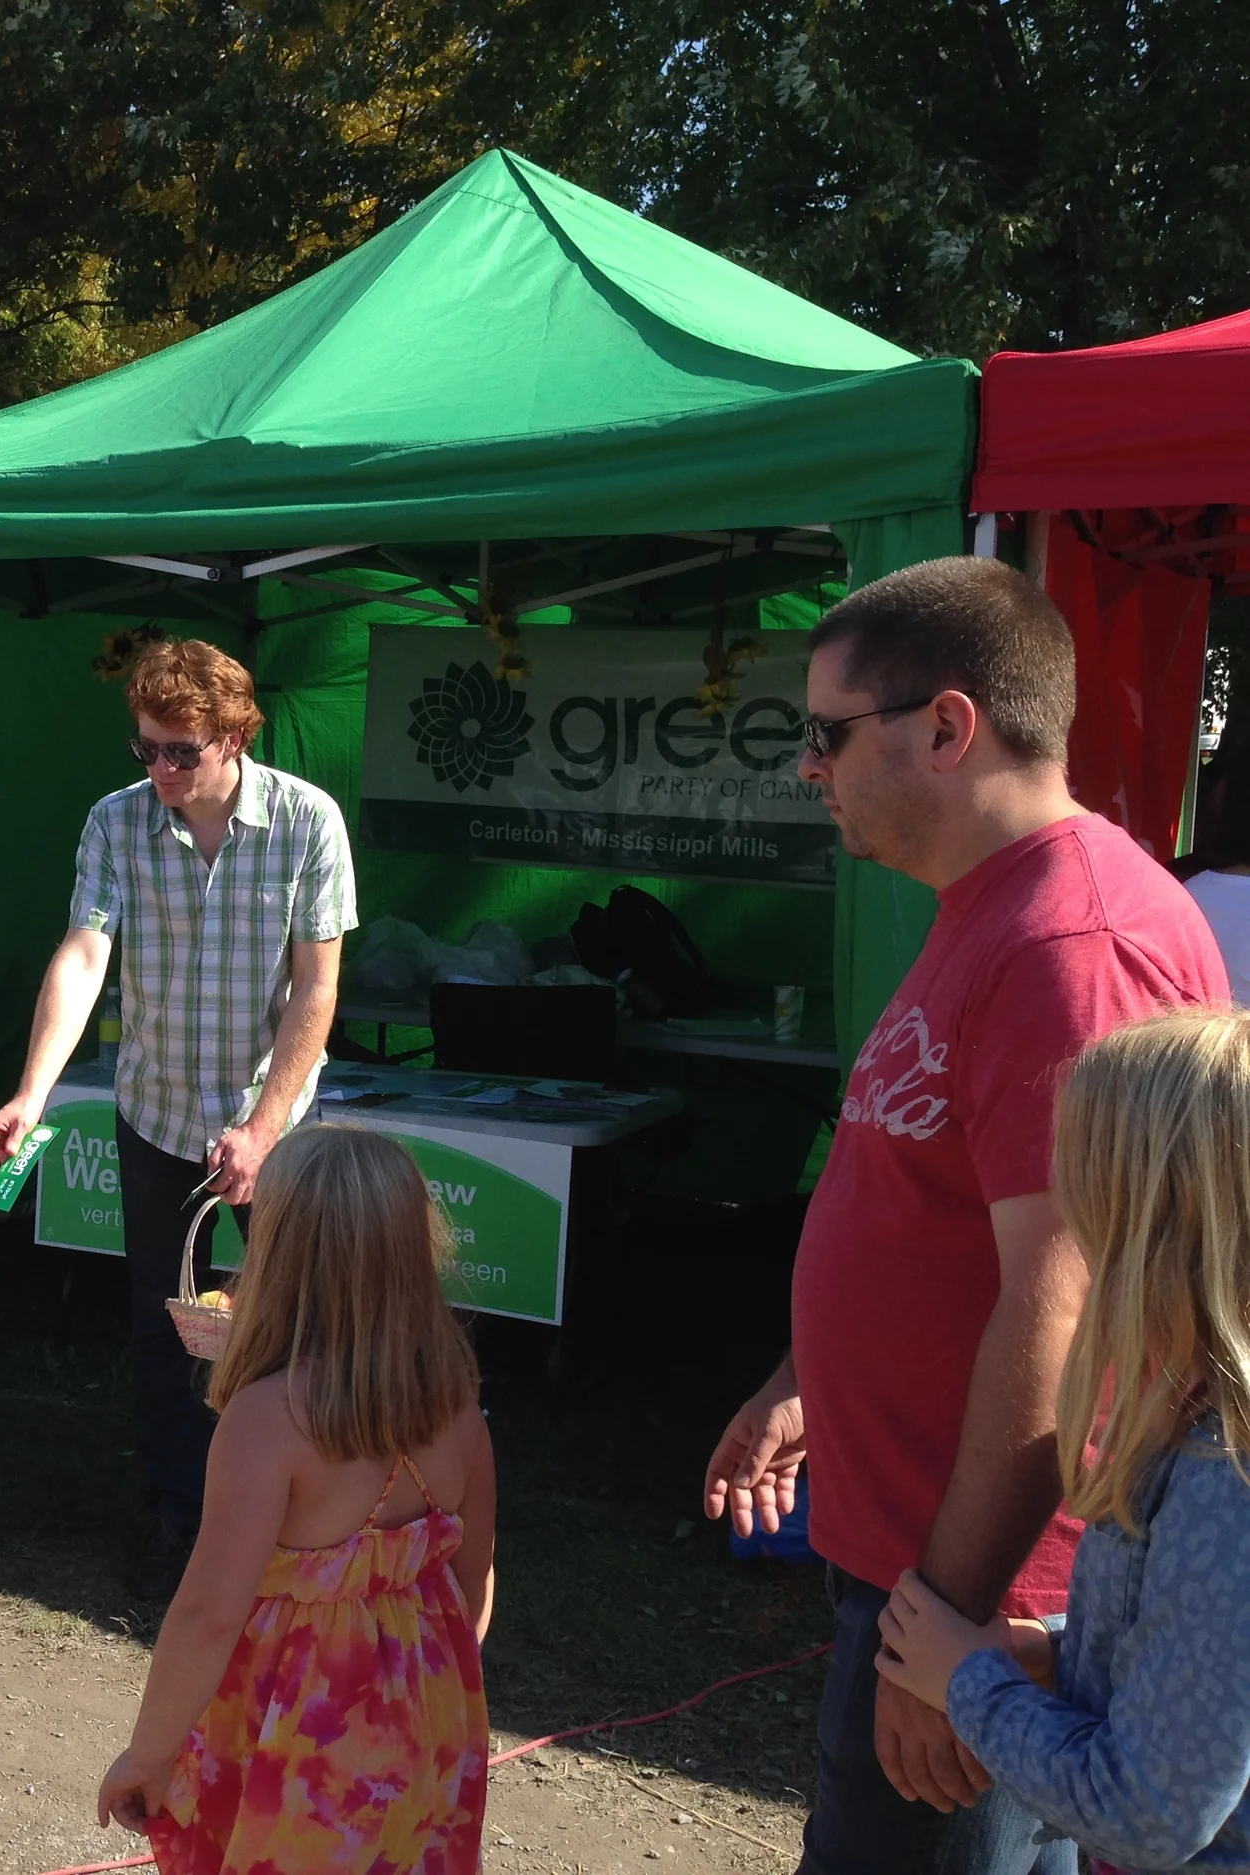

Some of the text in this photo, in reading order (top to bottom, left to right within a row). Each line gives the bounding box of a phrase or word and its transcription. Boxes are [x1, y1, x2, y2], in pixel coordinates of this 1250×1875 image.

[550, 695, 804, 792] gree
[640, 774, 713, 798] PARTY
[720, 778, 751, 799] OF
[468, 819, 558, 845] Carleton
[581, 827, 714, 860] Mississippi
[722, 834, 779, 859] Mills
[11, 1141, 40, 1176] green
[63, 1154, 121, 1194] We
